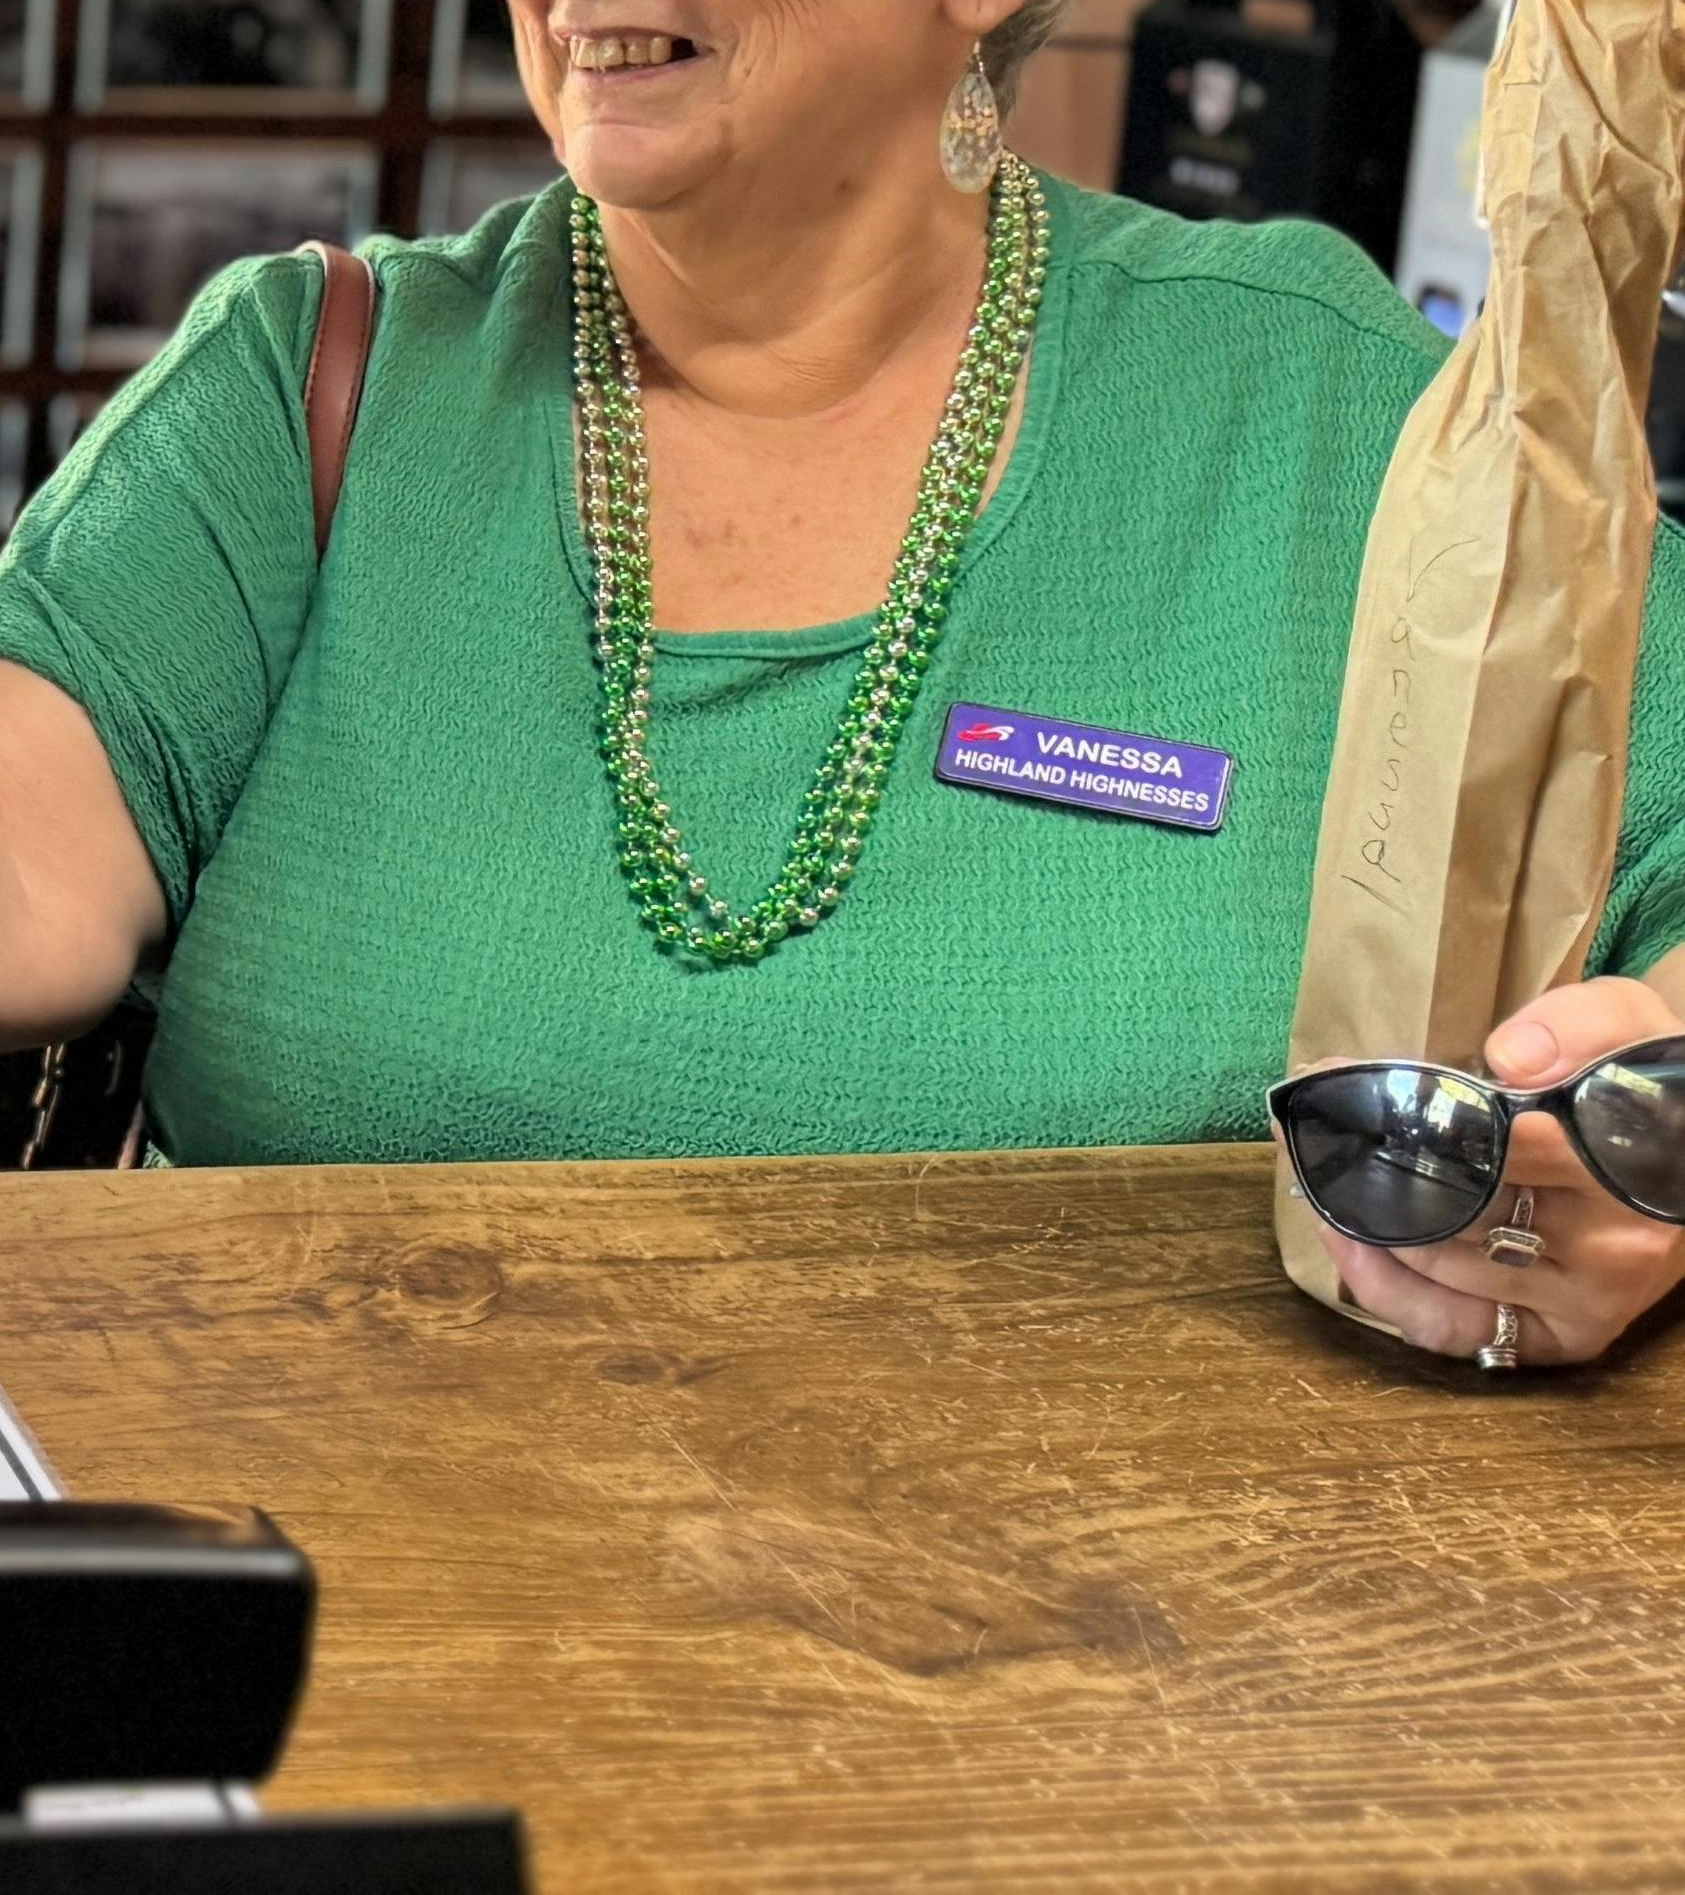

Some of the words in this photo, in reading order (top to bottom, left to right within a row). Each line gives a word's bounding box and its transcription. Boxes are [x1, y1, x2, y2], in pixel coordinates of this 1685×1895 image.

[955, 748, 1066, 785] HIGHLAND
[1069, 771, 1209, 812] HIGHNESSES
[1036, 731, 1183, 778] VANESSA
